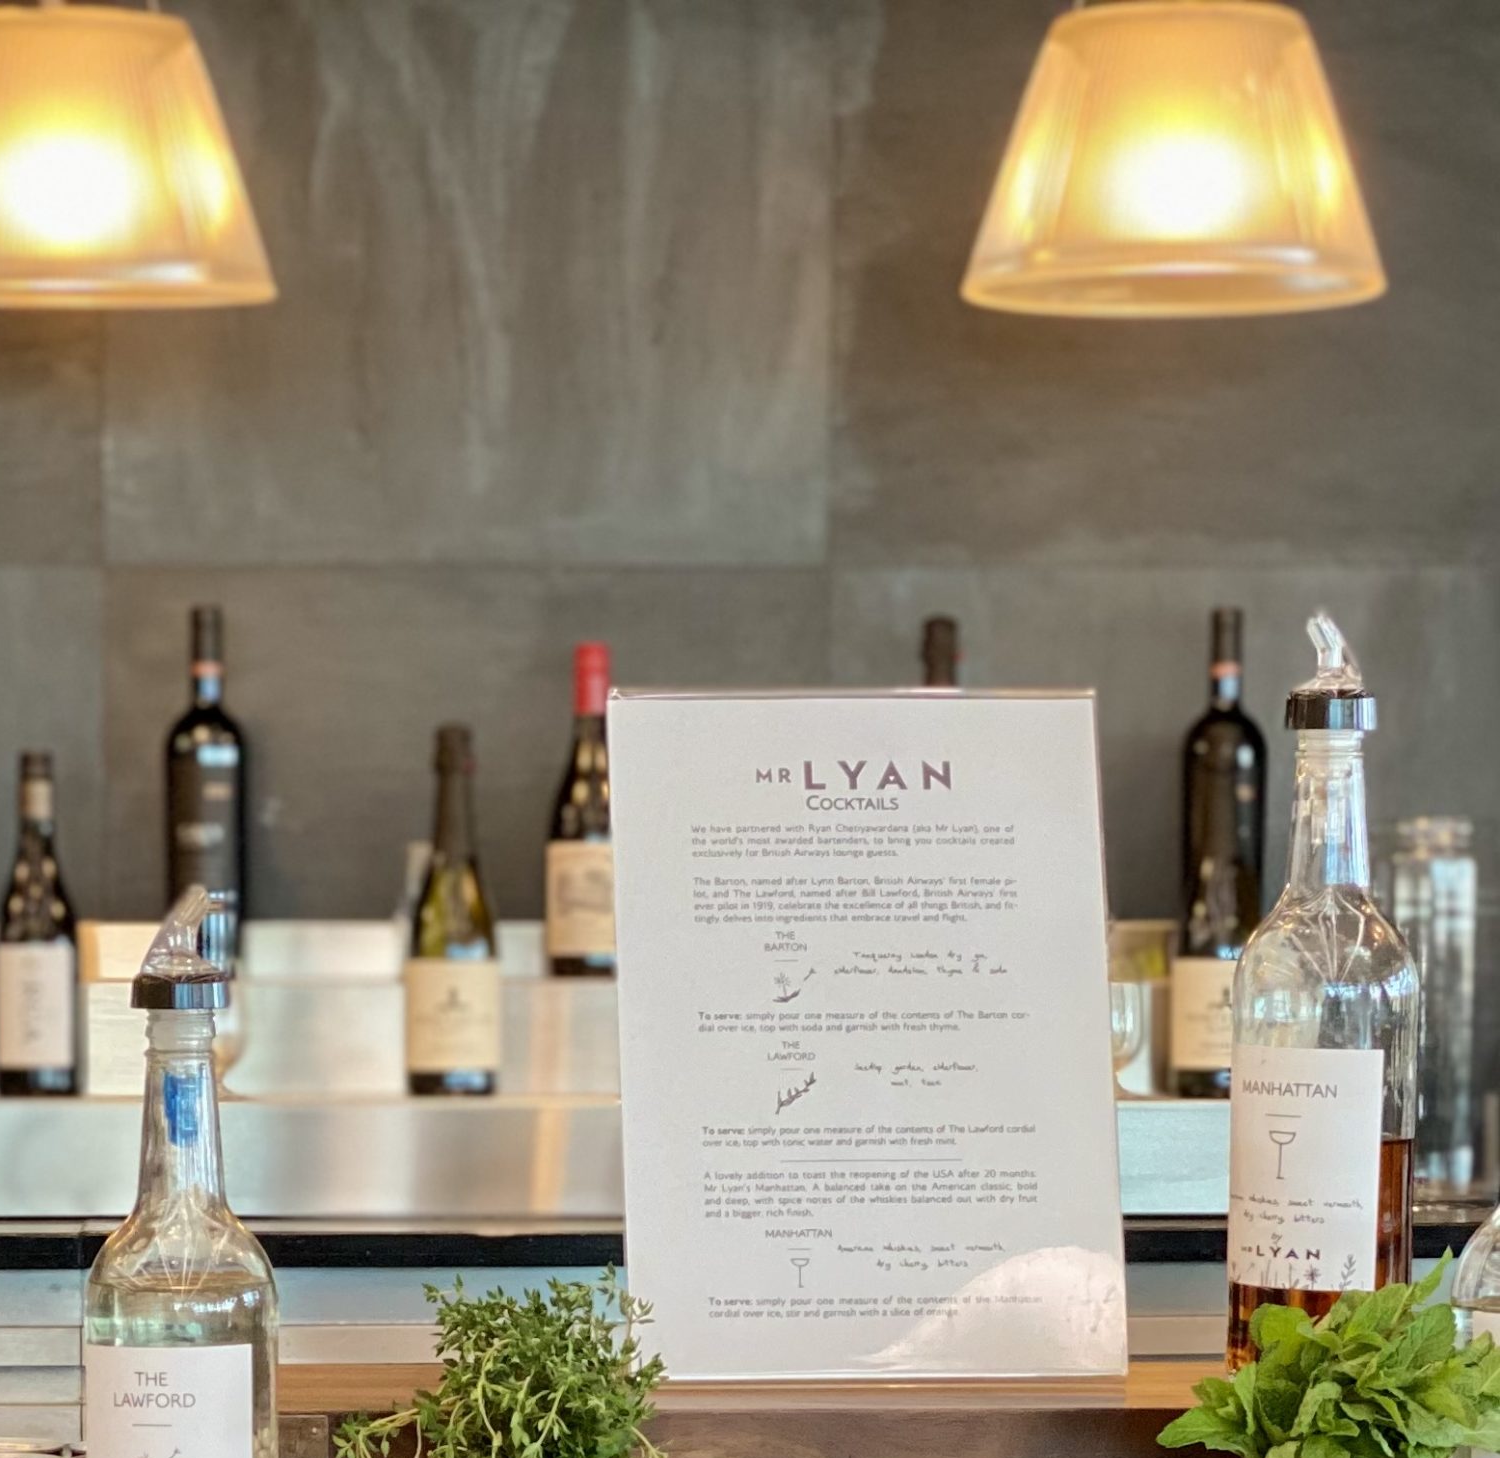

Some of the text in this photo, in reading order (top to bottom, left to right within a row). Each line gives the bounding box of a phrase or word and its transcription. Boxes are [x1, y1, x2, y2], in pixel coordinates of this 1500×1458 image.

[755, 760, 951, 790] MR LYAN
[806, 795, 899, 810] COCKTAILS
[710, 823, 732, 833] have
[736, 823, 781, 835] partnered
[785, 823, 804, 832] with
[808, 823, 831, 835] Ryan
[710, 836, 743, 845] world's
[747, 836, 770, 845] most
[774, 836, 813, 845] awarded
[887, 836, 911, 847] bring
[935, 836, 976, 845] cocktails
[980, 836, 1015, 845] created
[692, 847, 742, 859] exclusively
[762, 847, 791, 857] British
[794, 847, 830, 859] Airways
[833, 847, 864, 859] lounge
[751, 876, 782, 885] named
[786, 876, 808, 885] after
[811, 876, 834, 887] Lynn
[874, 876, 903, 885] British
[949, 876, 966, 885] first
[970, 876, 1001, 885] female
[800, 888, 831, 897] named
[836, 888, 857, 897] after
[861, 888, 876, 897] Bill
[924, 888, 953, 897] British
[999, 888, 1017, 897] first
[694, 902, 714, 910] ever
[718, 900, 738, 912] pilot
[778, 900, 821, 910] celebrate
[842, 900, 892, 910] excellence
[921, 900, 948, 912] things
[694, 912, 719, 924] tingly
[723, 912, 752, 922] delves
[754, 912, 774, 922] into
[775, 912, 827, 924] ingredients
[830, 912, 848, 922] that
[851, 912, 891, 922] embrace
[894, 912, 920, 922] travel
[775, 931, 796, 940] THE
[764, 943, 808, 952] BARTON
[746, 1010, 775, 1022] simply
[779, 1013, 800, 1022] pour
[901, 1010, 940, 1019] contents
[978, 1010, 1008, 1019] Barton
[698, 1022, 715, 1032] dial
[779, 1022, 798, 1031] with
[800, 1022, 823, 1031] soda
[845, 1022, 878, 1033] garnish
[880, 1021, 900, 1031] with
[903, 1021, 927, 1031] fresh
[782, 1041, 800, 1049] THE
[767, 1052, 816, 1061] LAWFORD
[1242, 1080, 1338, 1098] MANHATTAN
[748, 1125, 776, 1137] simply
[779, 1127, 800, 1137] pour
[895, 1124, 933, 1134] contents
[968, 1124, 1004, 1133] Lawford
[1006, 1124, 1036, 1133] cordial
[761, 1137, 780, 1146] with
[782, 1136, 805, 1146] tonic
[808, 1136, 833, 1146] water
[855, 1136, 886, 1148] garnish
[888, 1136, 908, 1145] with
[910, 1136, 933, 1145] fresh
[715, 1170, 743, 1182] lovely
[746, 1170, 785, 1179] addition
[803, 1169, 826, 1179] toast
[849, 1169, 896, 1181] reopening
[958, 1169, 980, 1178] after
[722, 1182, 750, 1194] Lyan's
[824, 1182, 866, 1191] balanced
[871, 1181, 891, 1191] take
[932, 1181, 976, 1190] American
[1017, 1181, 1038, 1190] bold
[754, 1194, 774, 1203] with
[778, 1194, 802, 1206] spice
[806, 1194, 832, 1203] notes
[869, 1193, 908, 1203] whiskies
[911, 1193, 953, 1202] balanced
[976, 1193, 996, 1202] with
[1018, 1193, 1038, 1202] fruit
[766, 1207, 784, 1216] rich
[765, 1228, 833, 1238] MANHATTAN
[1257, 1245, 1320, 1260] LYAN
[134, 1371, 168, 1387] THE
[113, 1393, 196, 1408] LAWFORD
